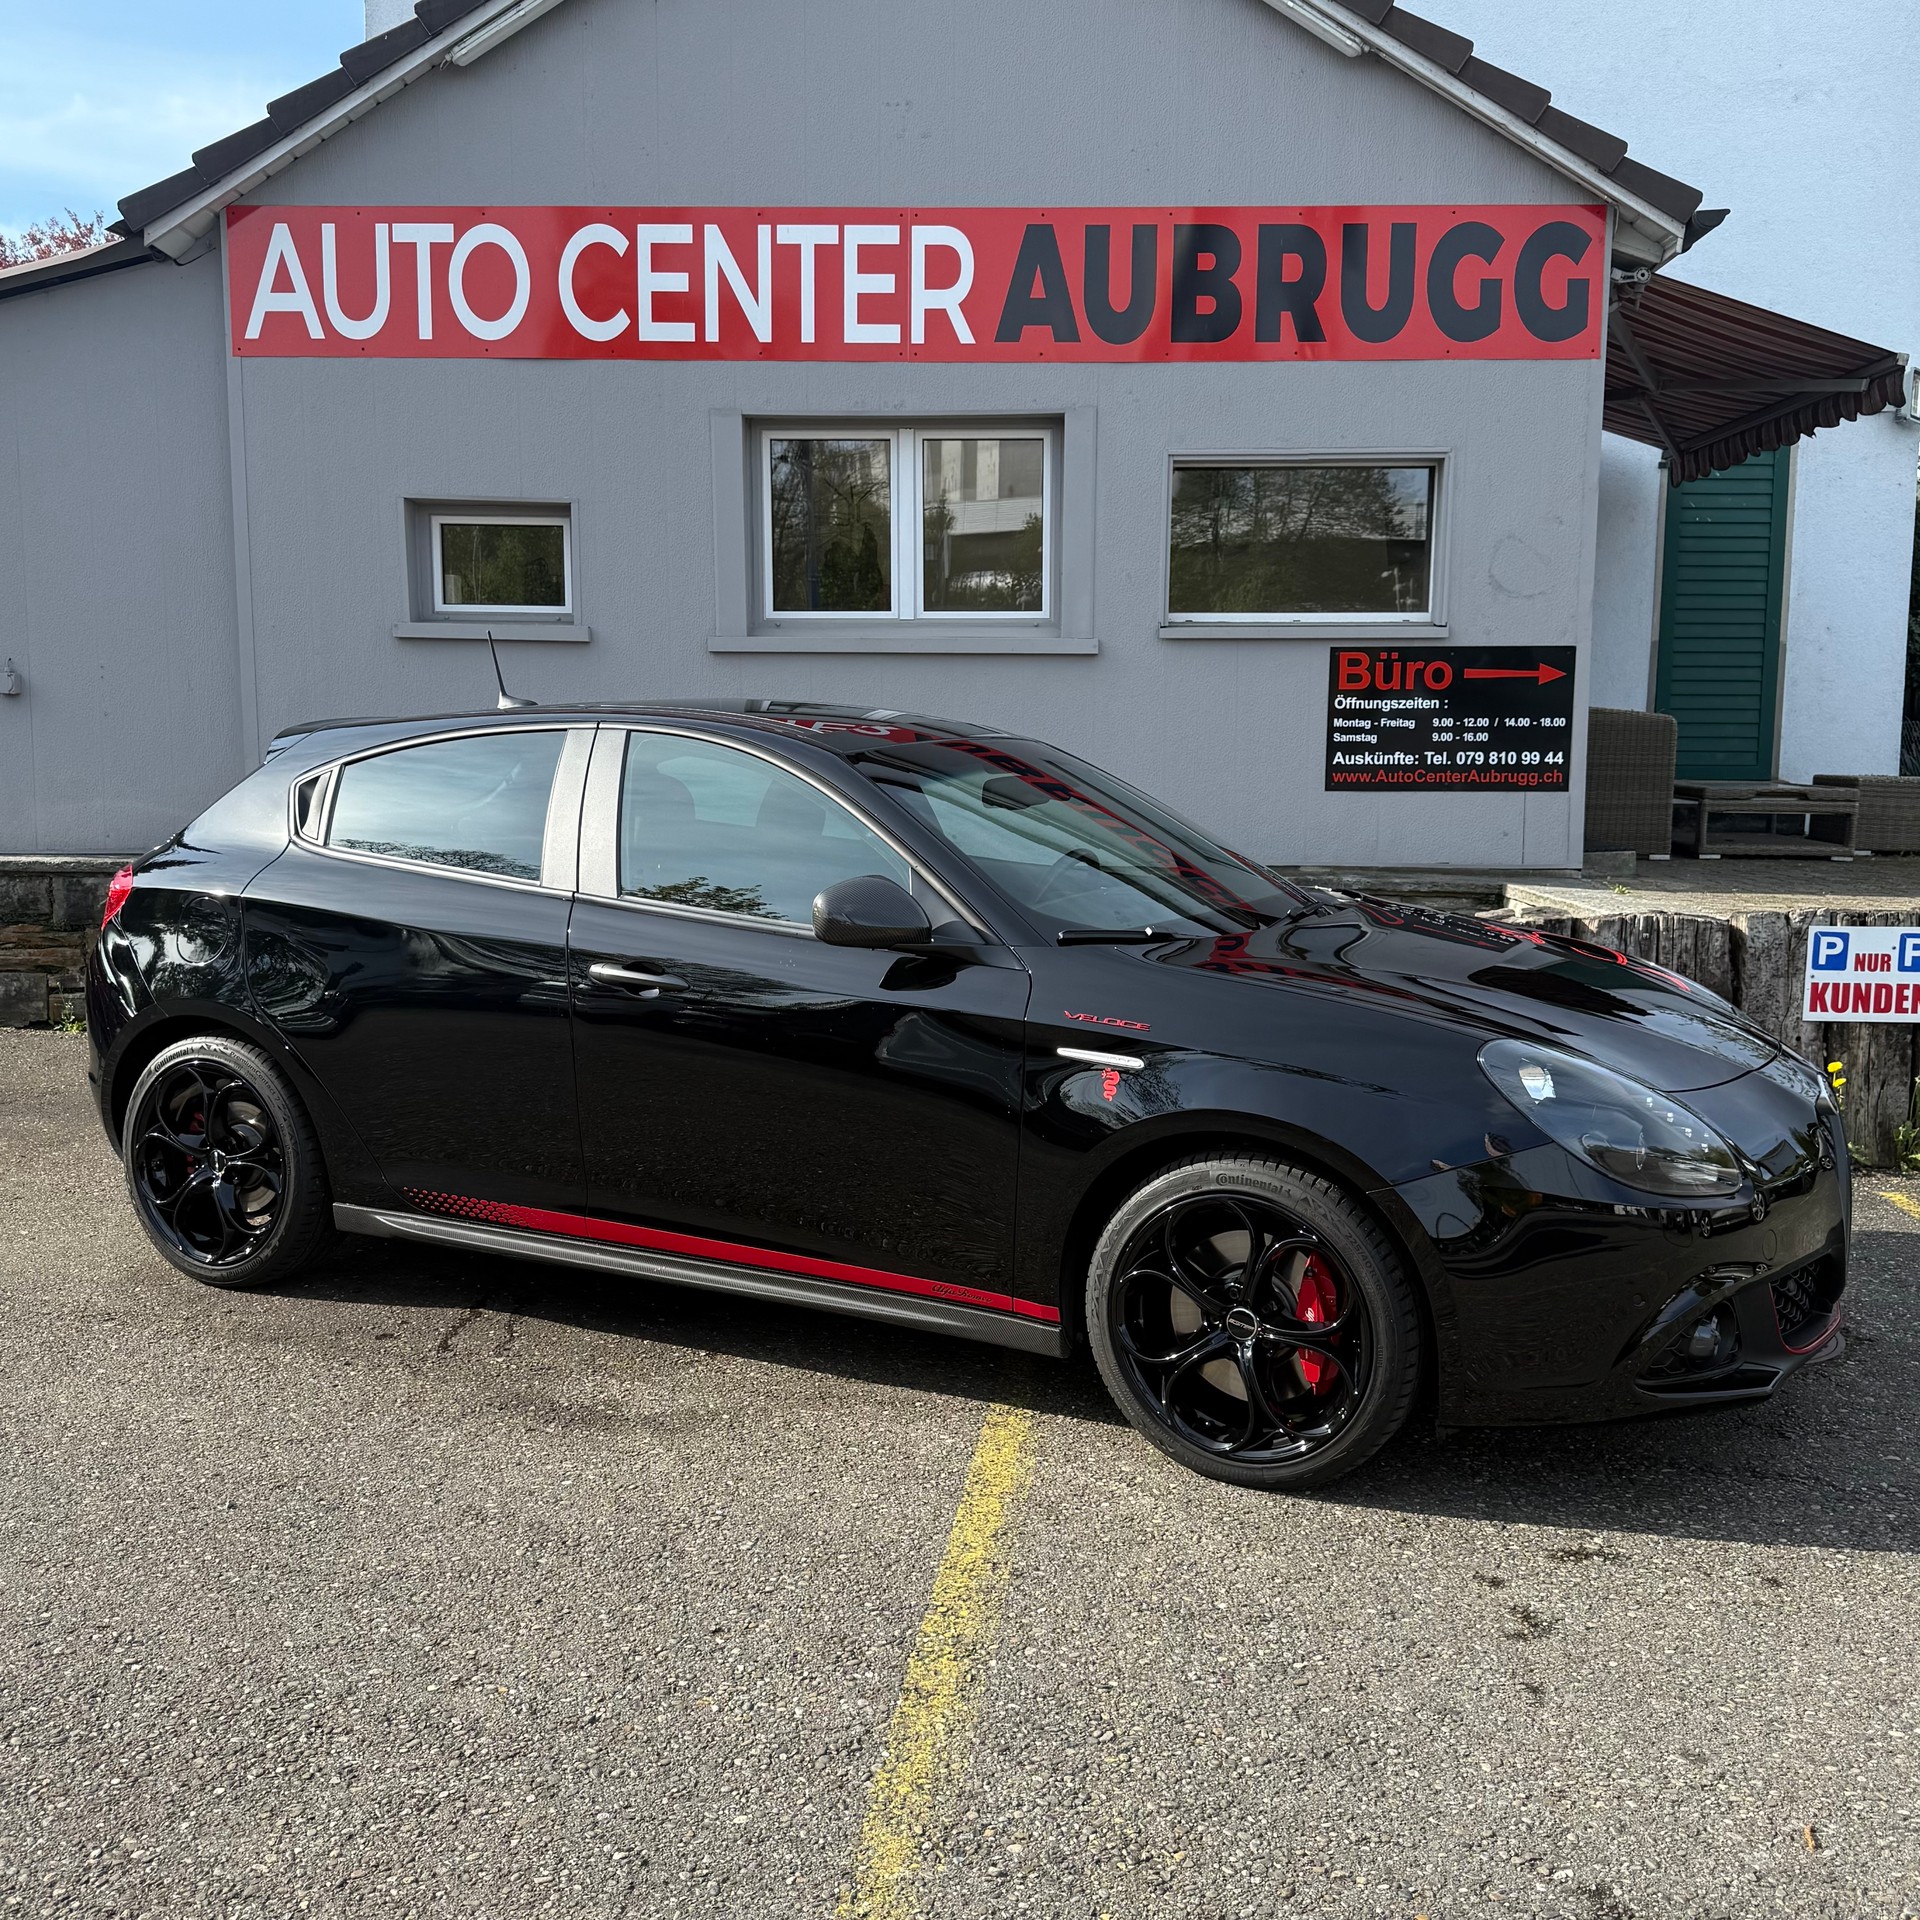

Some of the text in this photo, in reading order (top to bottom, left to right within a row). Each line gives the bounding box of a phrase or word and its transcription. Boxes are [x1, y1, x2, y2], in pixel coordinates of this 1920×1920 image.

[244, 220, 1593, 345] AUTO CENTER AUBRUGG
[1338, 651, 1453, 690] Büro
[1334, 694, 1440, 712] Öffnungszeiten
[1333, 718, 1371, 729] Montag
[1380, 718, 1416, 729] Freitag
[1432, 718, 1454, 727] 9.00
[1463, 718, 1489, 727] 12.00
[1504, 717, 1530, 727] 14.00
[1539, 717, 1566, 727] 18.00
[1333, 733, 1378, 744] Samstag
[1432, 733, 1453, 742] 9.00
[1463, 733, 1489, 742] 16.00
[1332, 751, 1564, 765] Auskünfte: Tel. 079 810 99 44
[1332, 769, 1563, 786] www.AutoCenterAubrugg.ch
[1817, 935, 1845, 966] P
[1853, 953, 1892, 972] NUR
[1063, 1010, 1152, 1032] VELOCE
[154, 1047, 189, 1072] Continental
[1215, 1173, 1284, 1194] Continental
